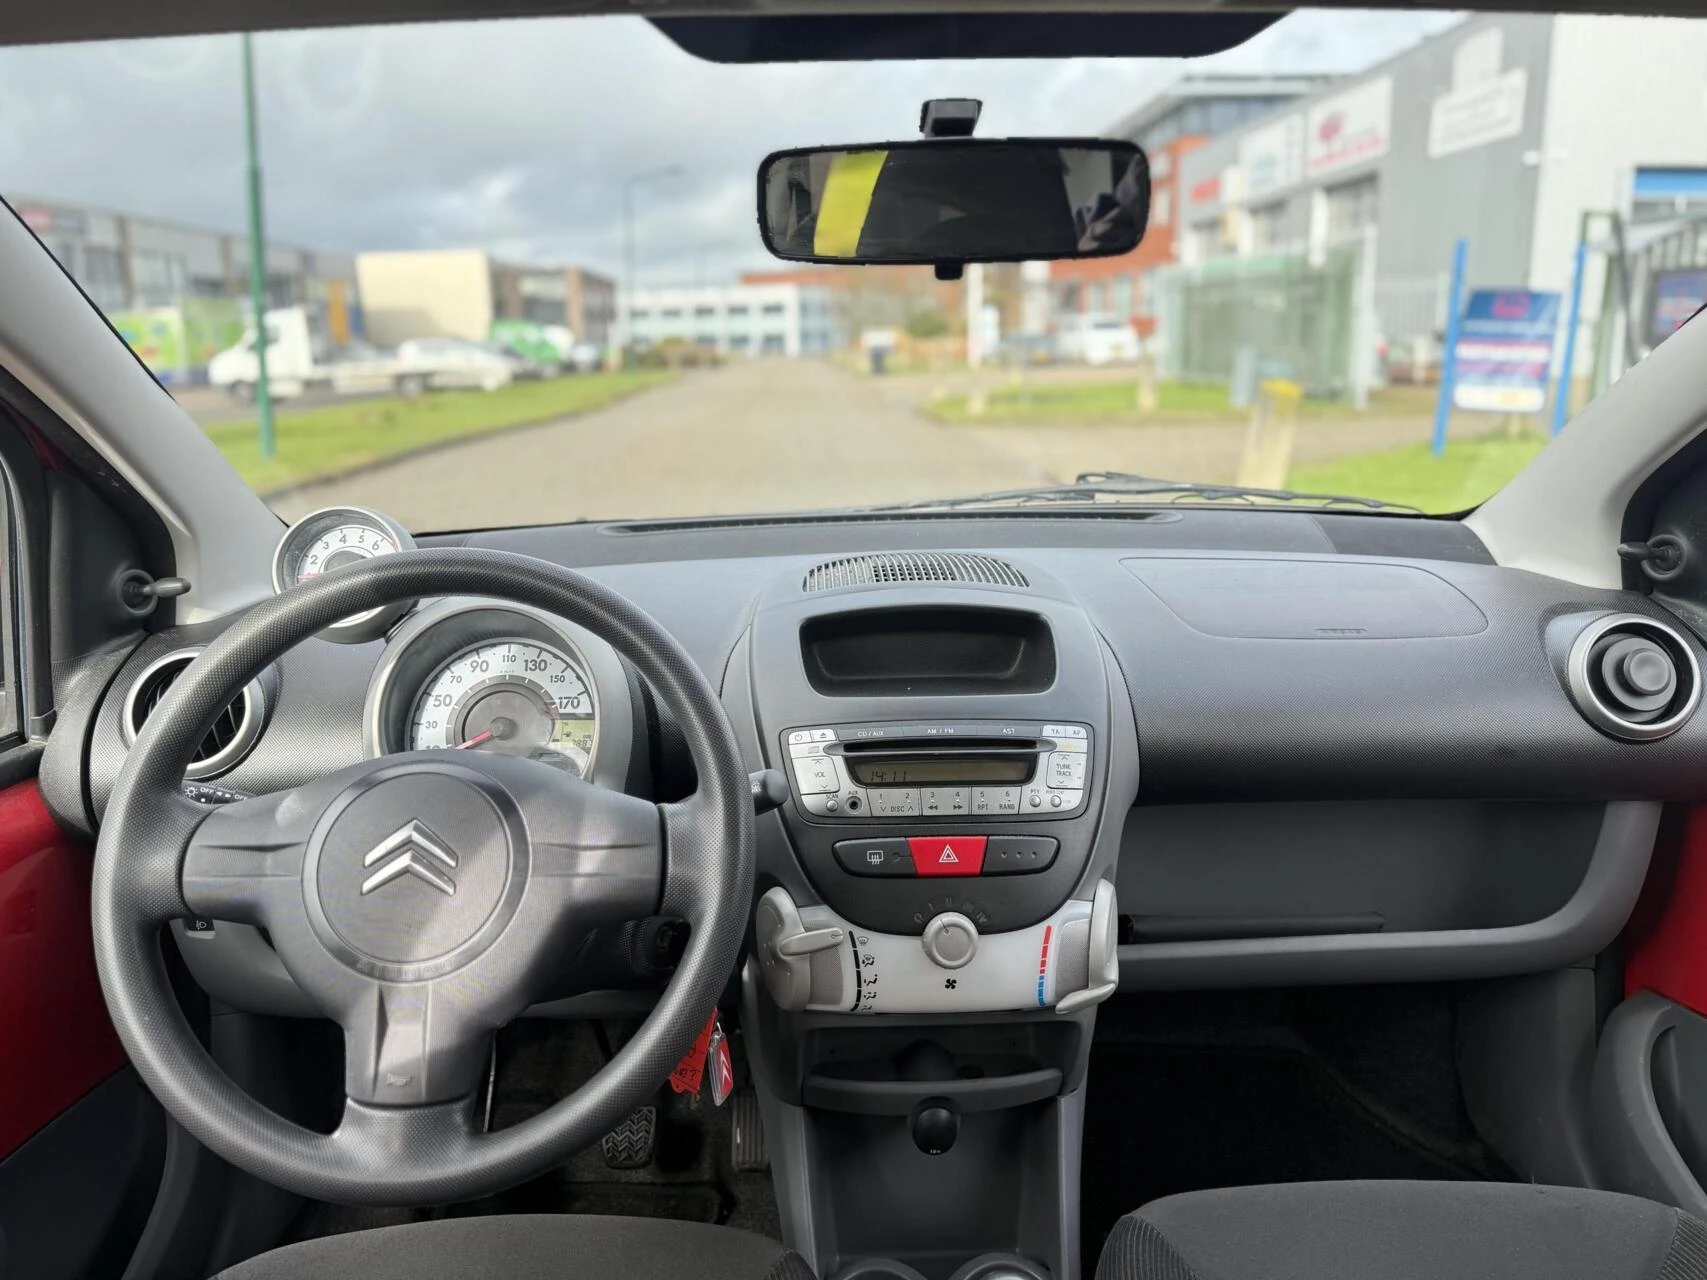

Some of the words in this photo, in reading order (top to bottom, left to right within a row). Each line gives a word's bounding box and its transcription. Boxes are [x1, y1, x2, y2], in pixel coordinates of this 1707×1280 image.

[339, 534, 347, 544] 4
[358, 535, 365, 543] 5
[322, 541, 330, 550] 3
[372, 540, 380, 550] 6
[310, 554, 318, 564] 2
[502, 654, 516, 663] 110
[470, 660, 489, 673] 90
[524, 659, 547, 672] 130
[450, 675, 462, 683] 70
[550, 674, 565, 683] 150
[432, 694, 452, 708] 50
[558, 696, 580, 710] 170
[425, 721, 438, 729] 30
